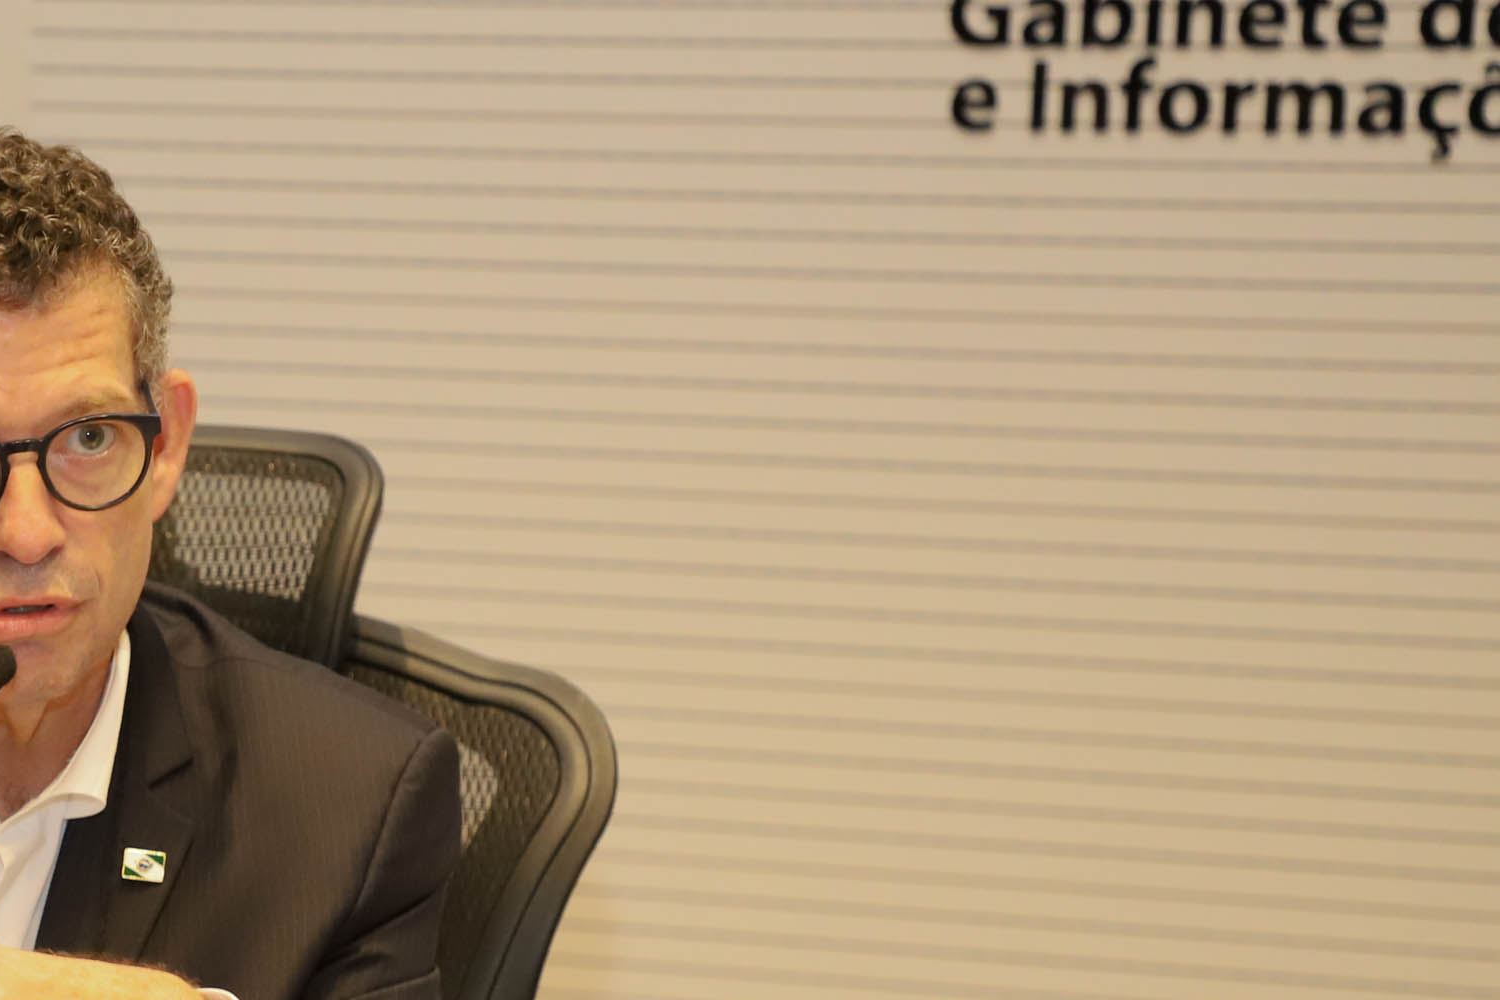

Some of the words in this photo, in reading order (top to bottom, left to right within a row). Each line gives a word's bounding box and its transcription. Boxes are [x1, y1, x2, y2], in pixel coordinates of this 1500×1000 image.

[949, 0, 1388, 49] Gabinete
[1419, 0, 1500, 49] d
[950, 77, 997, 132] e
